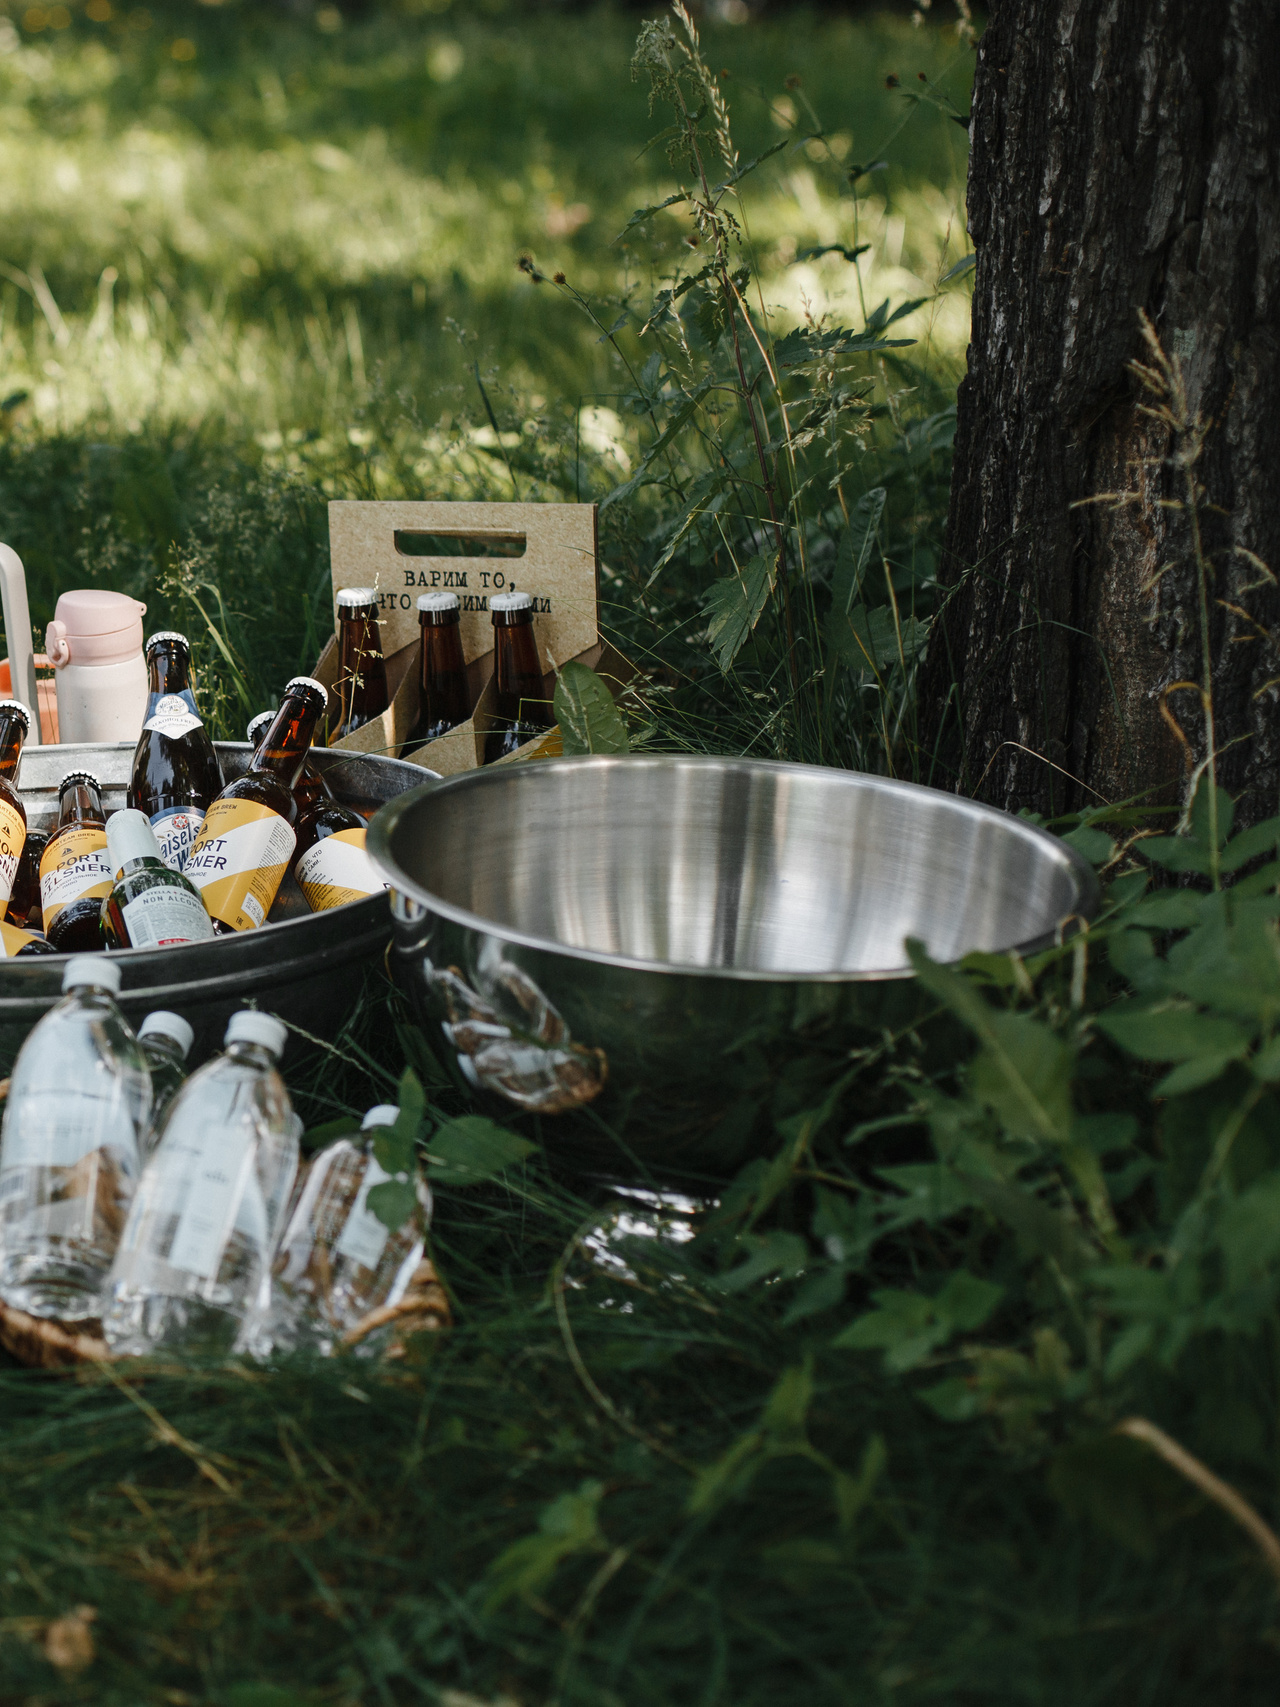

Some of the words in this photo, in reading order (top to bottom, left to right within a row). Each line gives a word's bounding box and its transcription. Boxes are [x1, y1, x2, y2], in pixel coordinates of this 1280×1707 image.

[404, 570, 469, 588] ВАРИМ
[480, 571, 516, 592] ТО,
[143, 896, 164, 905] NON
